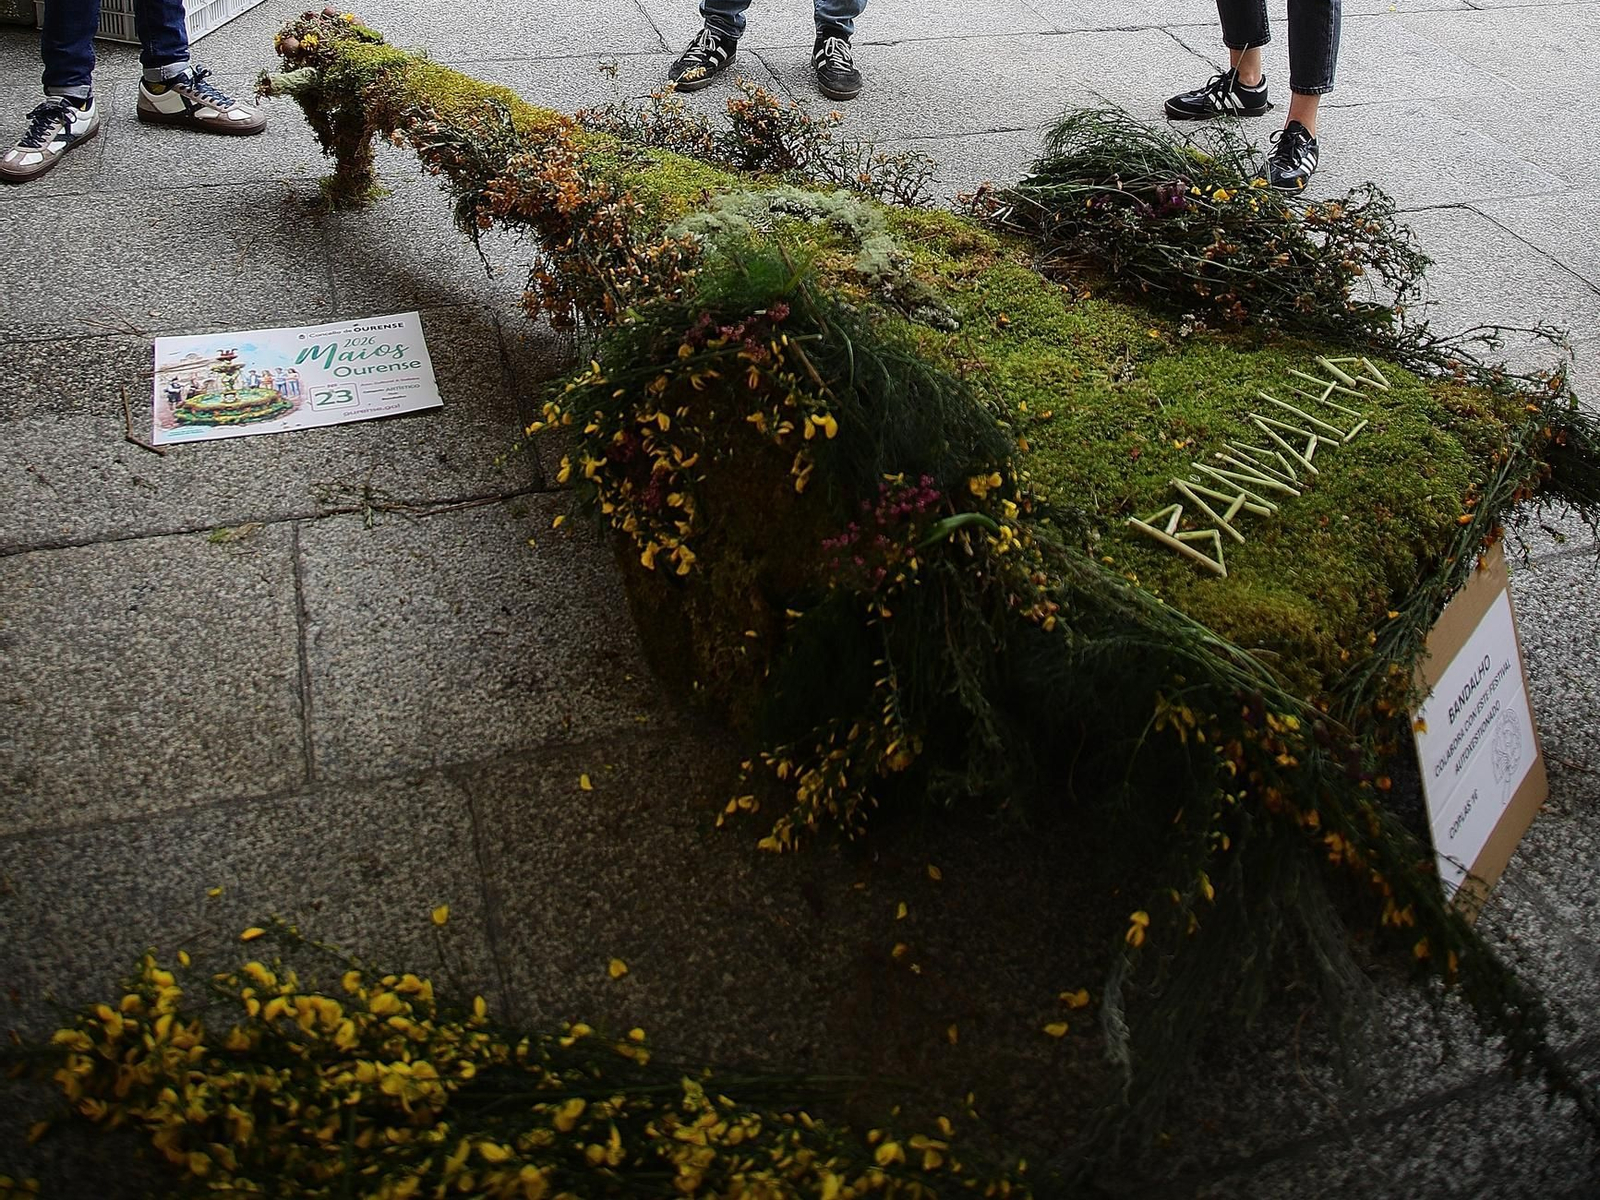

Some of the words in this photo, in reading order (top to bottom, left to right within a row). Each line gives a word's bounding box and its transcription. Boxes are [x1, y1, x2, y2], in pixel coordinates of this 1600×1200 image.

[344, 335, 377, 348] 2026
[295, 343, 410, 369] Maios
[334, 360, 421, 377] Ourense
[315, 389, 353, 406] 23
[1448, 654, 1491, 725] BANDALHO
[1434, 728, 1465, 778] COLABORA
[1489, 659, 1511, 695] FESTIVAL
